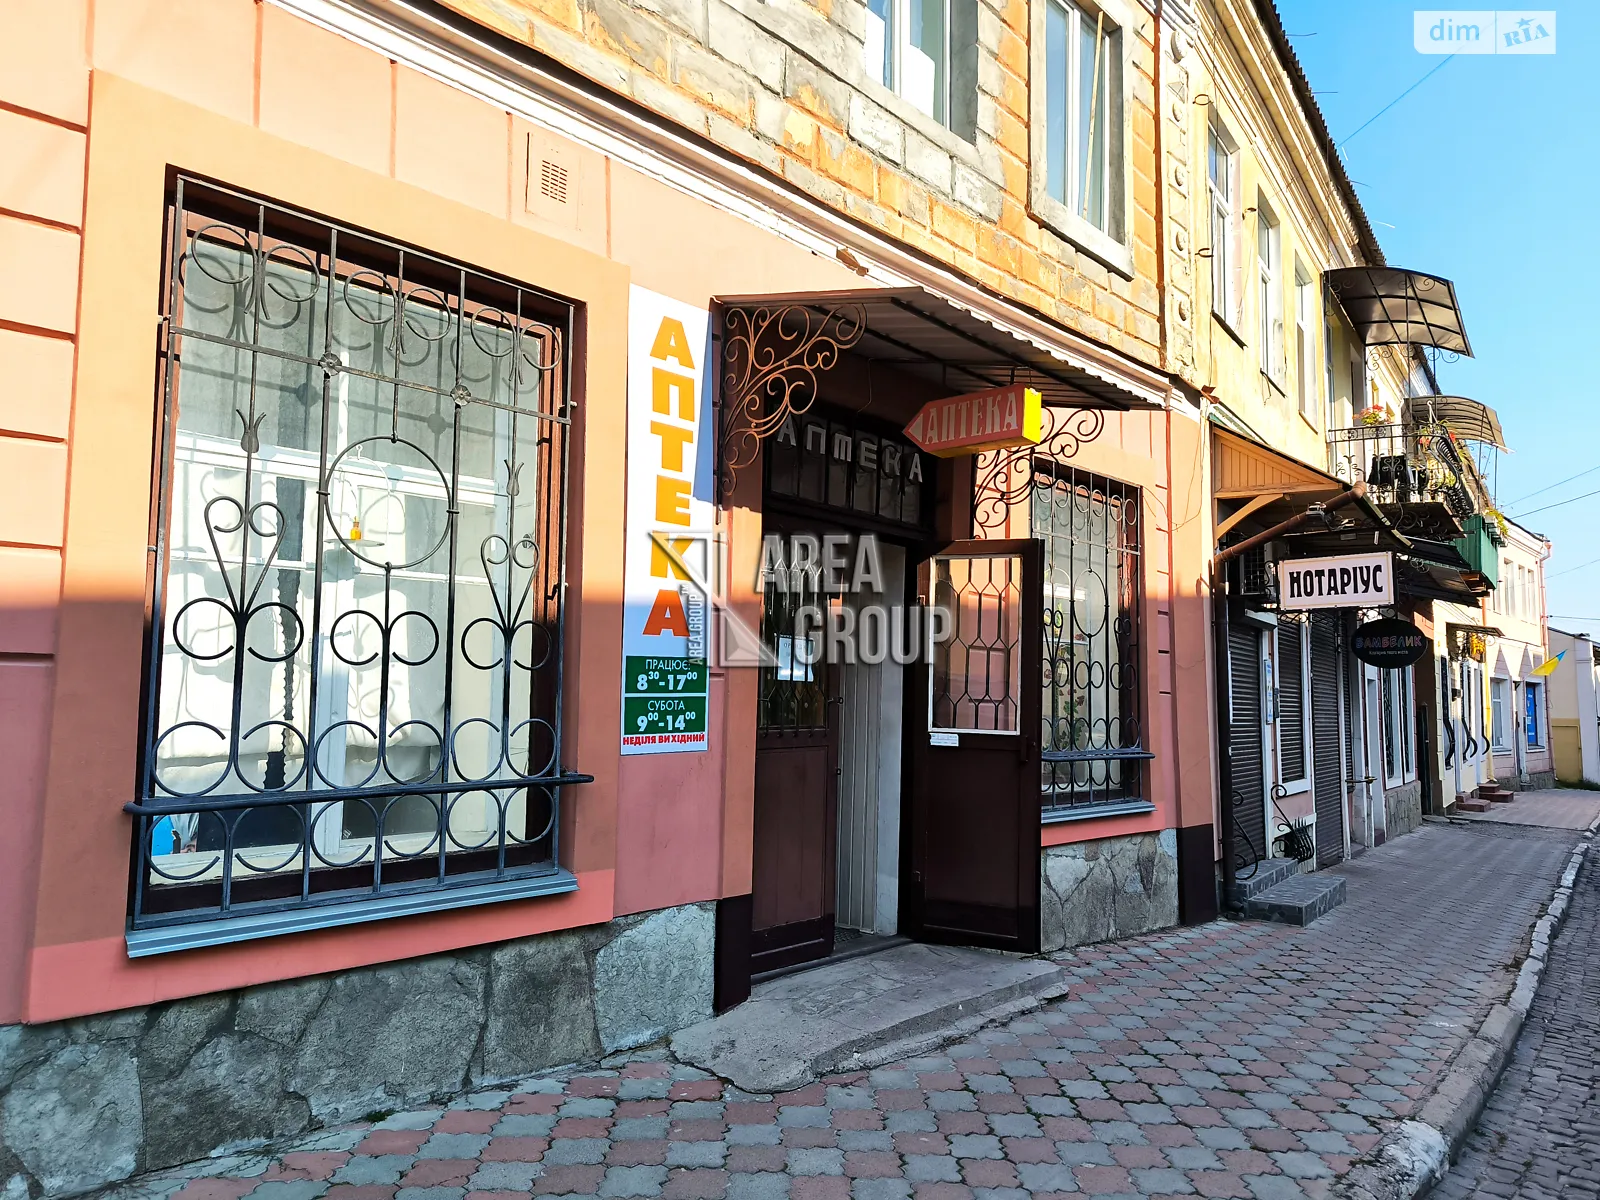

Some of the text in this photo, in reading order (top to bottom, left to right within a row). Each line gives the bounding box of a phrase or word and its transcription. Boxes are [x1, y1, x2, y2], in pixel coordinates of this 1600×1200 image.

[925, 391, 1018, 445] АПТЕКА
[642, 316, 695, 637] АПТЕКА
[1289, 564, 1383, 598] НОТАРІУС
[645, 659, 691, 671] ПРАЦЮЄ:
[647, 700, 685, 711] СУБОТА
[622, 735, 657, 746] НЕДІЛЯ
